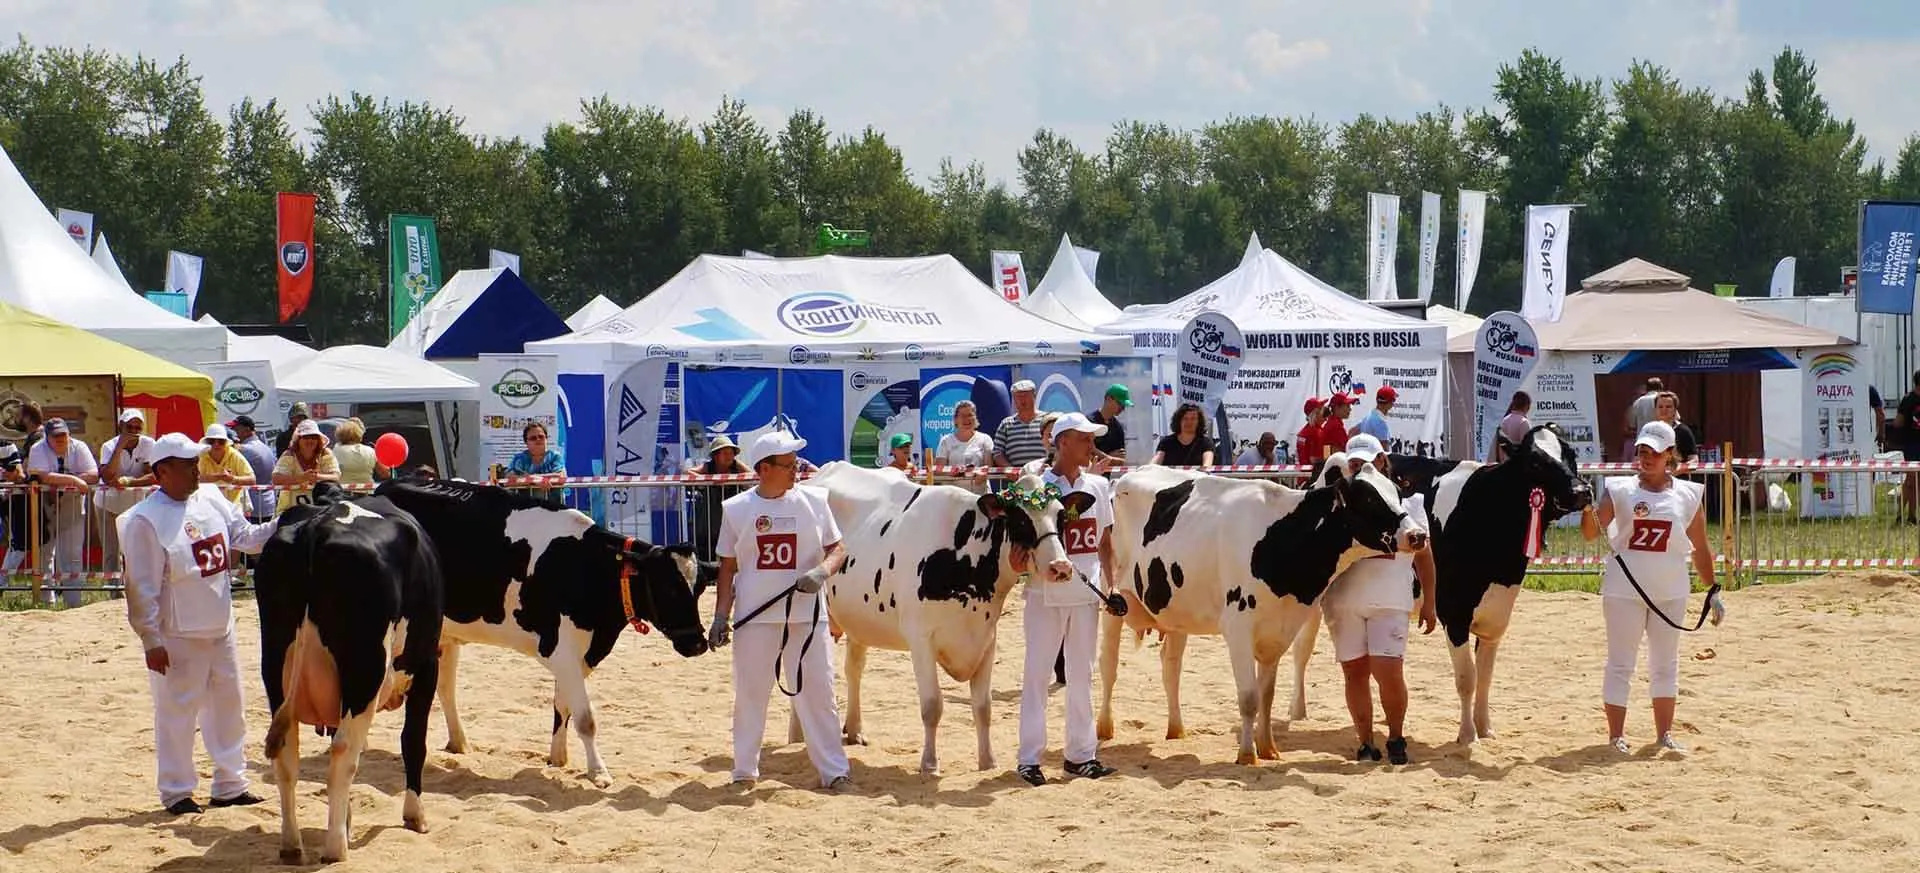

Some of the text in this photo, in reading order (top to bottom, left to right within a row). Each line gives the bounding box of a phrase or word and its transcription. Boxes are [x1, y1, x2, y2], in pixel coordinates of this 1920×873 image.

[792, 303, 943, 327] КОНТИНЕНТАЛ
[1196, 320, 1217, 331] WWS
[1491, 319, 1511, 331] WWS
[1133, 333, 1150, 348] WIDE
[1152, 333, 1170, 348] SIRES
[1245, 332, 1421, 349] WORLD WIDE SIRES RUSSIA
[1200, 353, 1230, 365] RUSSIA
[1496, 351, 1524, 364] RUSSIA
[1228, 381, 1285, 390] ЕРА ИНДУСТРИИ
[1816, 385, 1854, 399] РАДУГА
[1070, 526, 1097, 549] 26
[1633, 527, 1666, 547] 27
[199, 543, 224, 571] 29
[761, 543, 792, 565] 30
